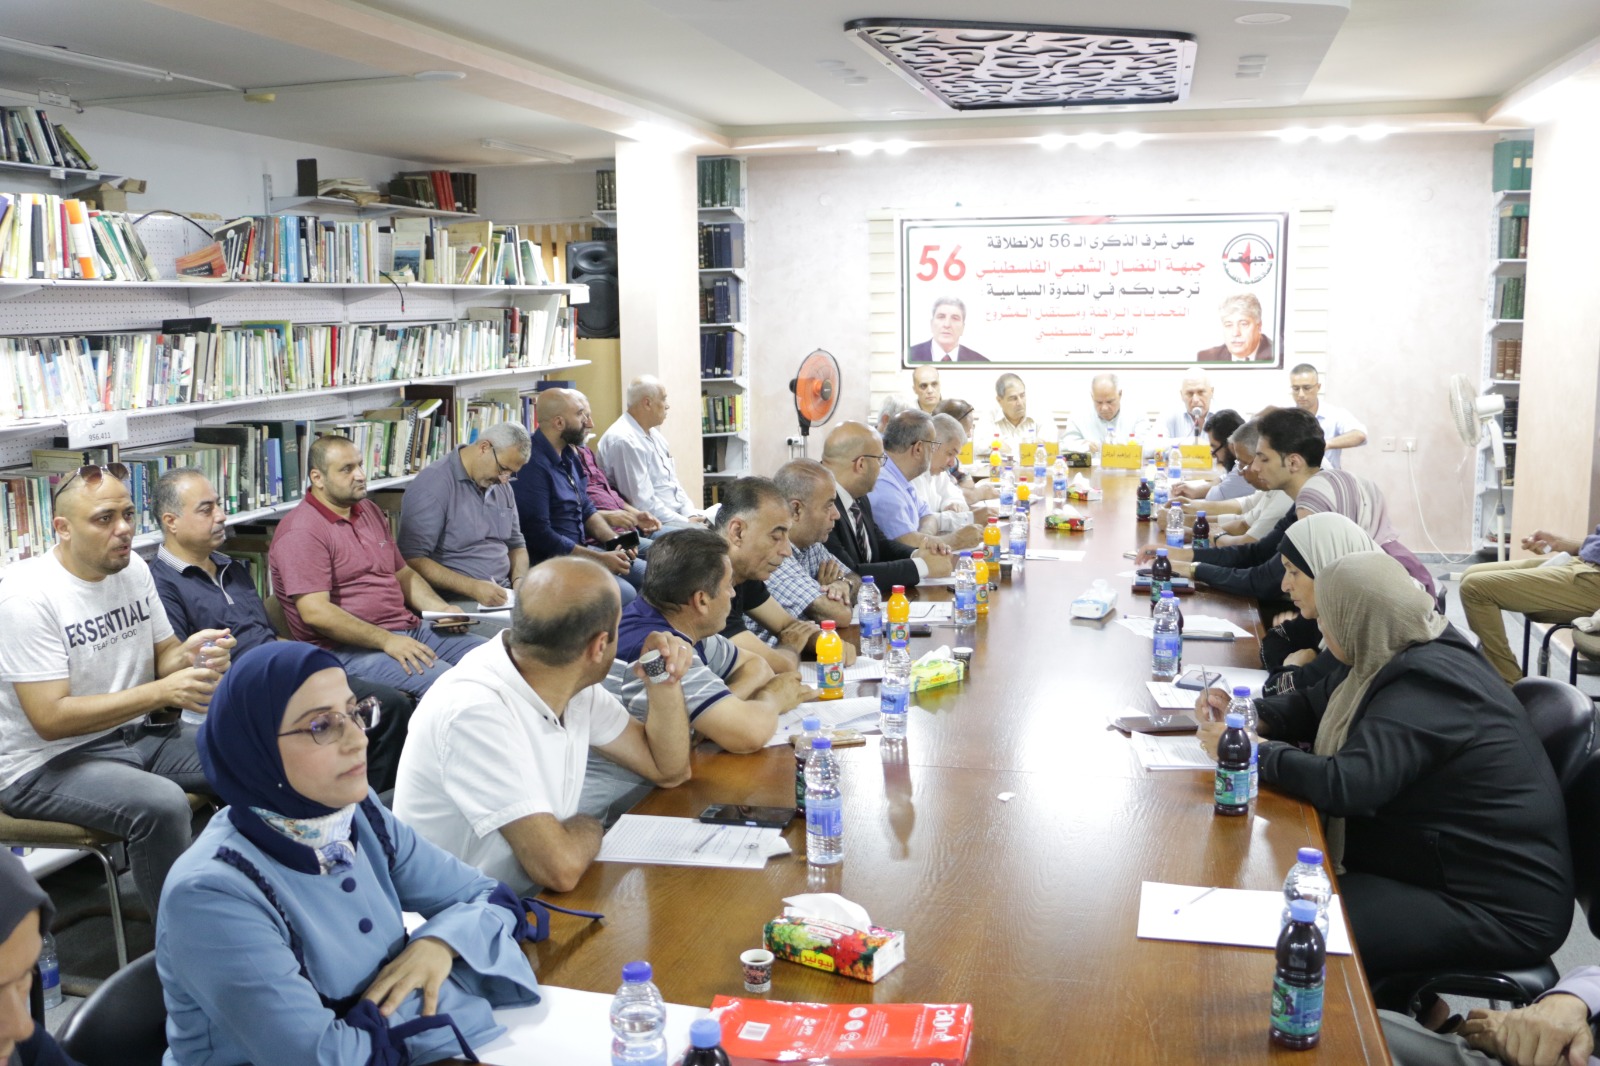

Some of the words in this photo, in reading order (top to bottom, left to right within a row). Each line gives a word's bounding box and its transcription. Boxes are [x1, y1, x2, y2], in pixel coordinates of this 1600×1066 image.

[987, 234, 1044, 250] للانطلاقة
[1049, 233, 1071, 248] 56
[1090, 233, 1138, 250] الذكرى
[1141, 234, 1168, 250] شرف
[1171, 233, 1195, 249] على
[916, 244, 967, 281] 56
[975, 259, 1051, 281] الفلسطيني
[1054, 257, 1106, 280] الشعبي
[986, 282, 1046, 301] السياسية
[1049, 282, 1090, 300] الندوة
[1093, 281, 1115, 301] في
[1119, 281, 1155, 300] بكم
[1158, 281, 1201, 301] ترحب
[110, 635, 119, 645] OF
[121, 628, 138, 640] GOD
